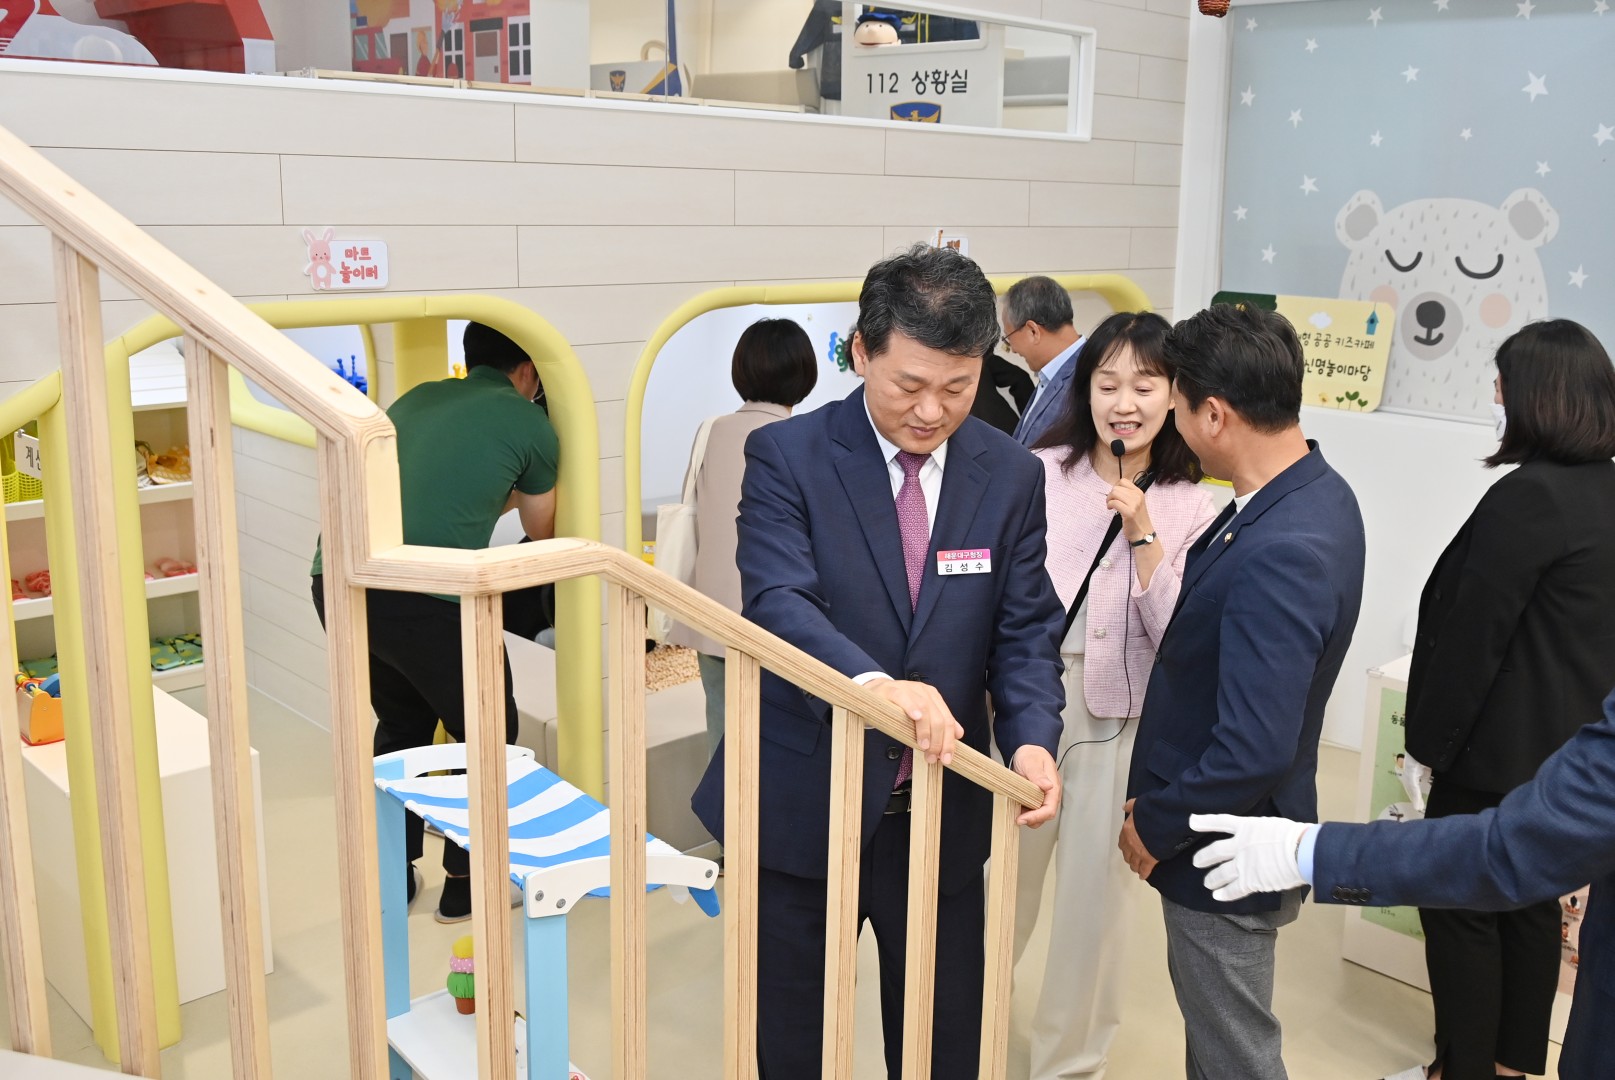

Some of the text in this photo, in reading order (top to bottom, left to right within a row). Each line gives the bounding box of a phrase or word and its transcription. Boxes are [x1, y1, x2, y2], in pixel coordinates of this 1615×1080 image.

[867, 69, 968, 95] 112 상황실
[344, 246, 372, 262] 마트
[339, 261, 379, 284] 놀이터
[1298, 332, 1311, 346] 형
[1313, 332, 1332, 348] 공공
[944, 551, 983, 560] 해운대구청장
